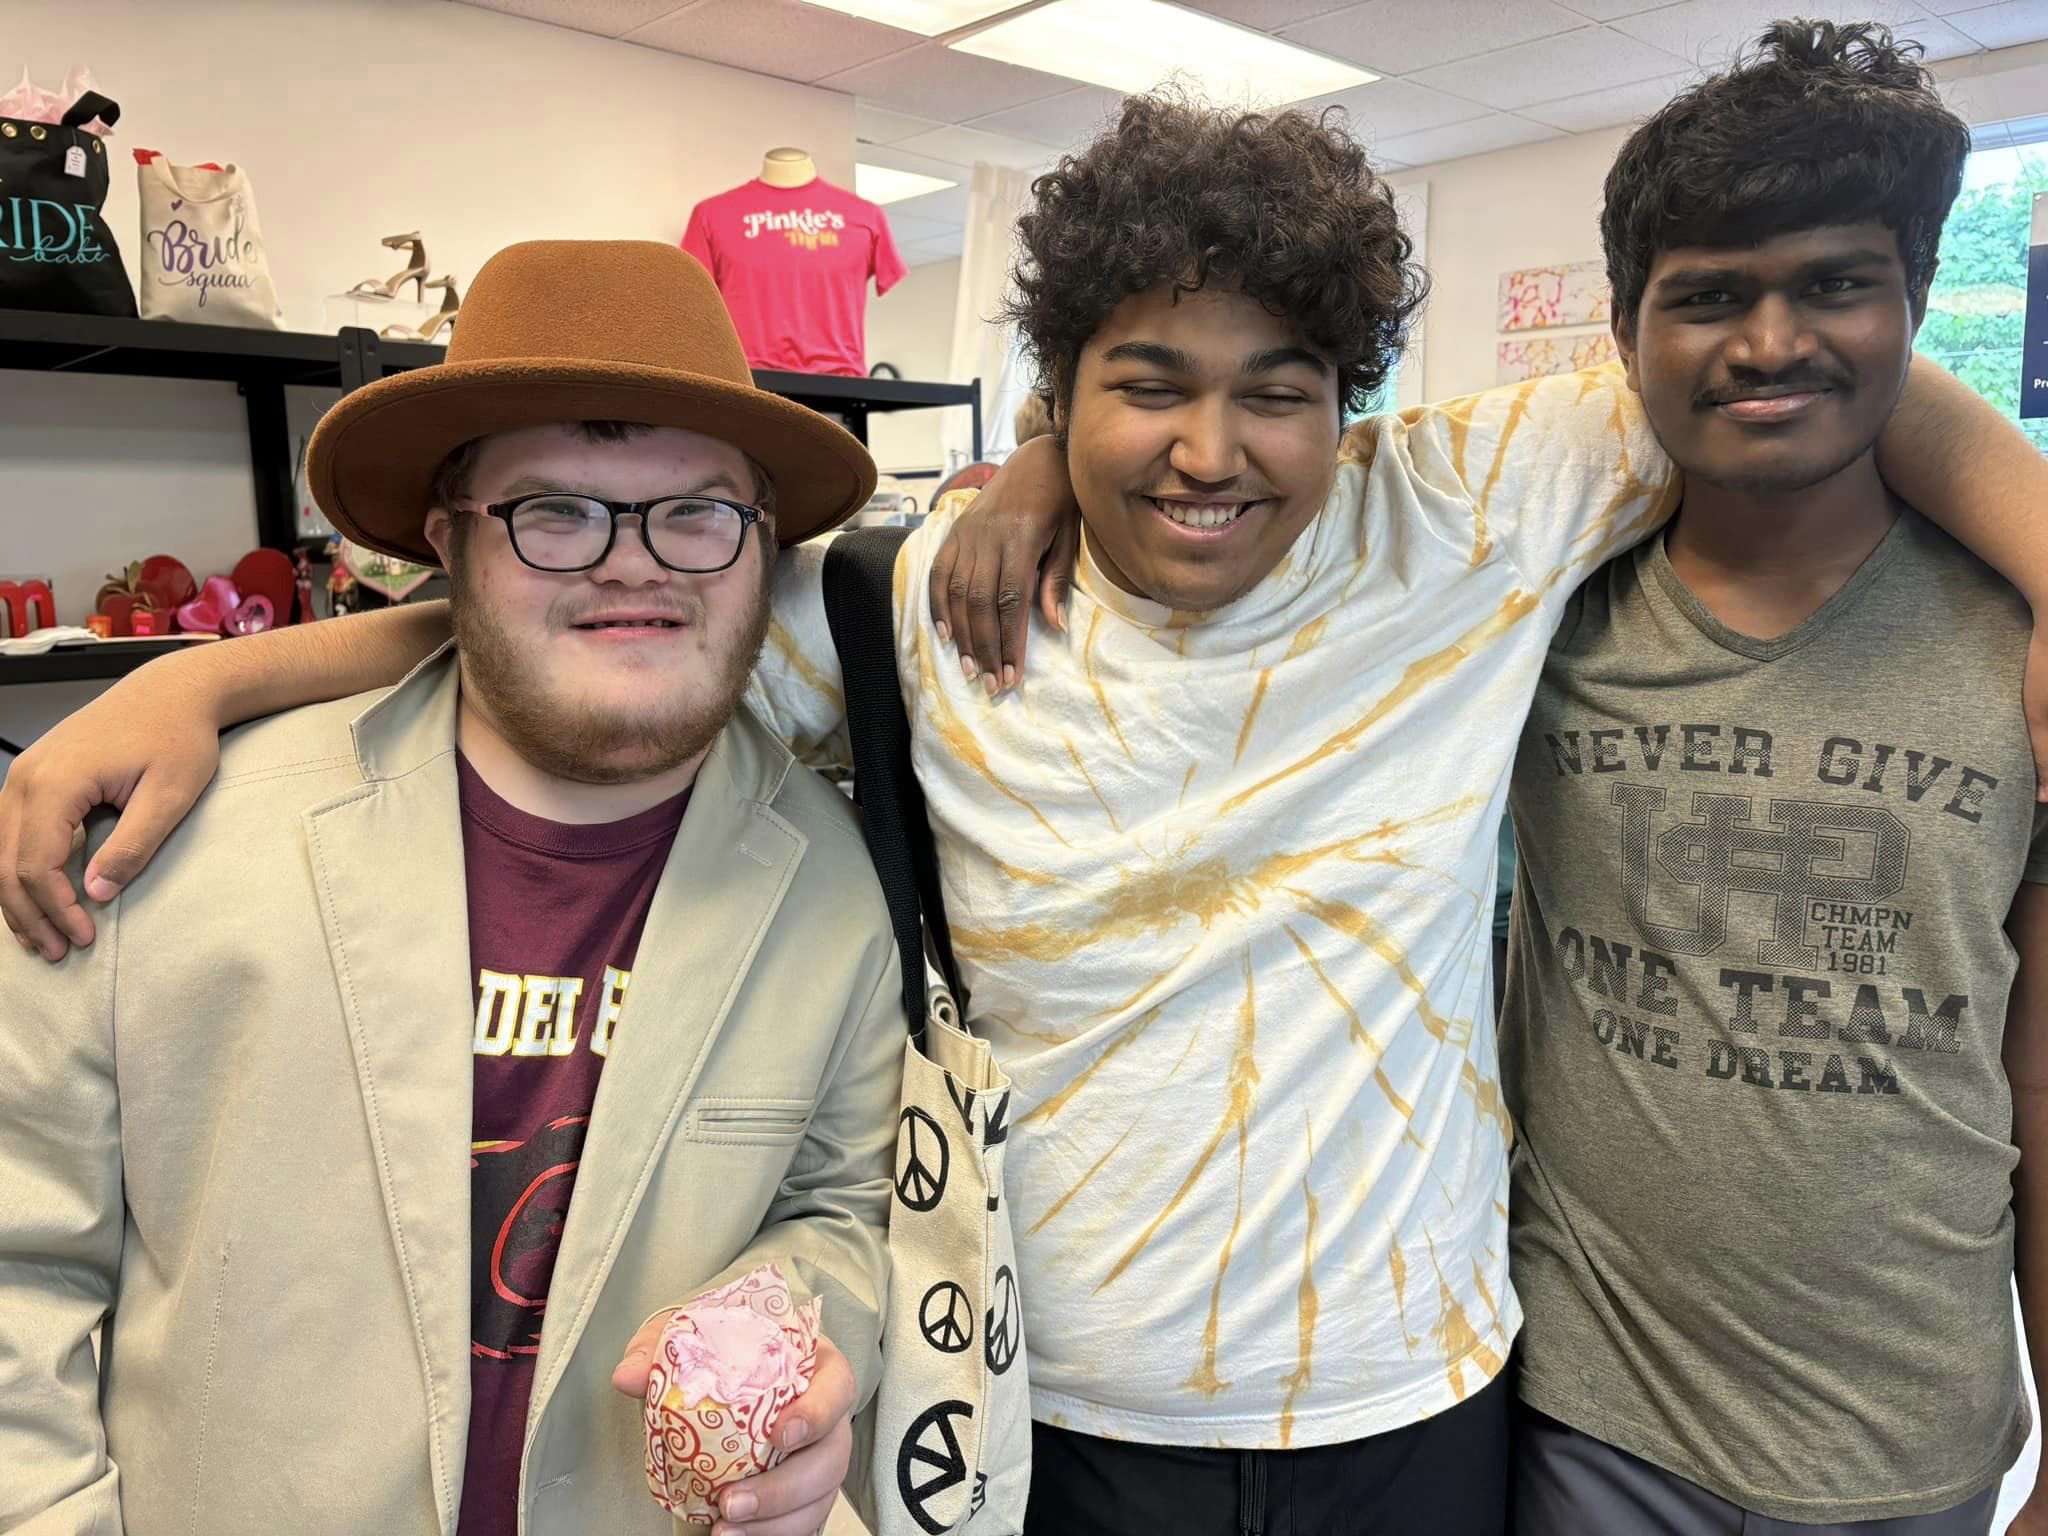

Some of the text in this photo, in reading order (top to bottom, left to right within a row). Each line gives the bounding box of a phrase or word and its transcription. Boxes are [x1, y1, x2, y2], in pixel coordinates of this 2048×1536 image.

[147, 214, 257, 274] Bride
[743, 208, 845, 238] Pinkie's
[1544, 724, 1999, 824] NEVER GIVE
[1811, 902, 1914, 930] CHMPN
[1822, 925, 1898, 954] TEAM
[1827, 951, 1887, 975] 1981
[1556, 926, 1969, 1054] ONE TEAM
[1592, 1008, 1901, 1094] ONE DREAM
